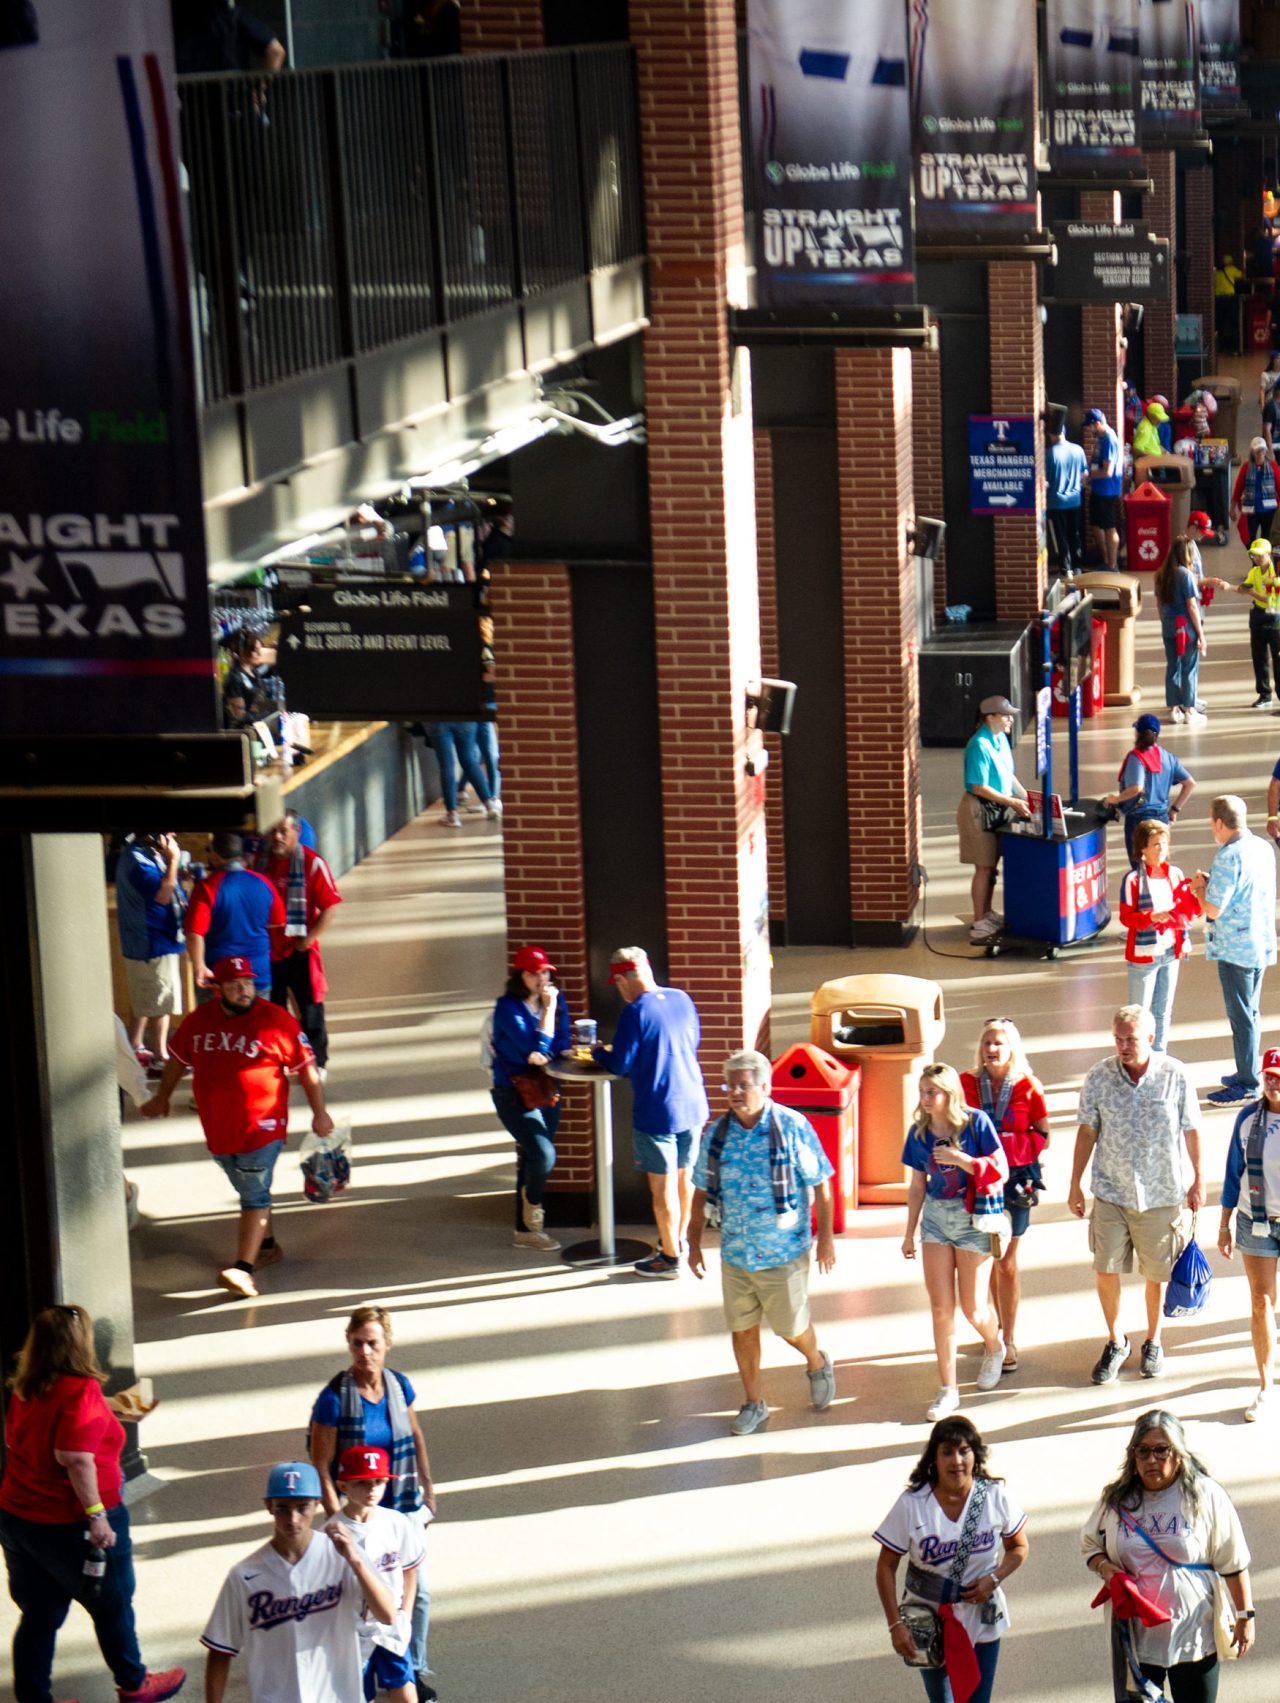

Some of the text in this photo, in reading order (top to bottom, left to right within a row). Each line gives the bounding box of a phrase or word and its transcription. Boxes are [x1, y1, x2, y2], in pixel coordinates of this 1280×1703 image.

[1054, 109, 1134, 120] STRAIGHT
[938, 116, 973, 133] Globe
[973, 116, 997, 133] Life
[1054, 119, 1078, 146] UP
[920, 152, 1027, 167] STRAIGHT
[785, 162, 831, 182] Globe
[831, 160, 861, 181] Life
[920, 166, 952, 200] UP
[952, 184, 1028, 200] TEXAS
[763, 208, 902, 228] STRAIGHT
[1067, 223, 1135, 237] Globe Life Field
[764, 227, 804, 266] UP
[804, 247, 904, 267] TEXAS
[1094, 251, 1124, 264] SECTIONS
[16, 408, 82, 444] Life
[993, 420, 1010, 440] T
[970, 455, 1034, 466] TEXAS RANGERS
[973, 468, 1032, 480] MERCHANDISE
[982, 481, 1024, 493] AVAILABLE
[333, 590, 449, 608] Globe Life Field
[304, 634, 452, 652] ALL SUITES AND EVENT LEVEL
[1076, 885, 1088, 908] &
[230, 958, 248, 970] T
[192, 1031, 262, 1058] TEXAS
[1270, 1051, 1280, 1064] T
[364, 1452, 380, 1470] T
[284, 1470, 301, 1490] T
[919, 1530, 996, 1567] Raners
[248, 1582, 343, 1630] Rangers
